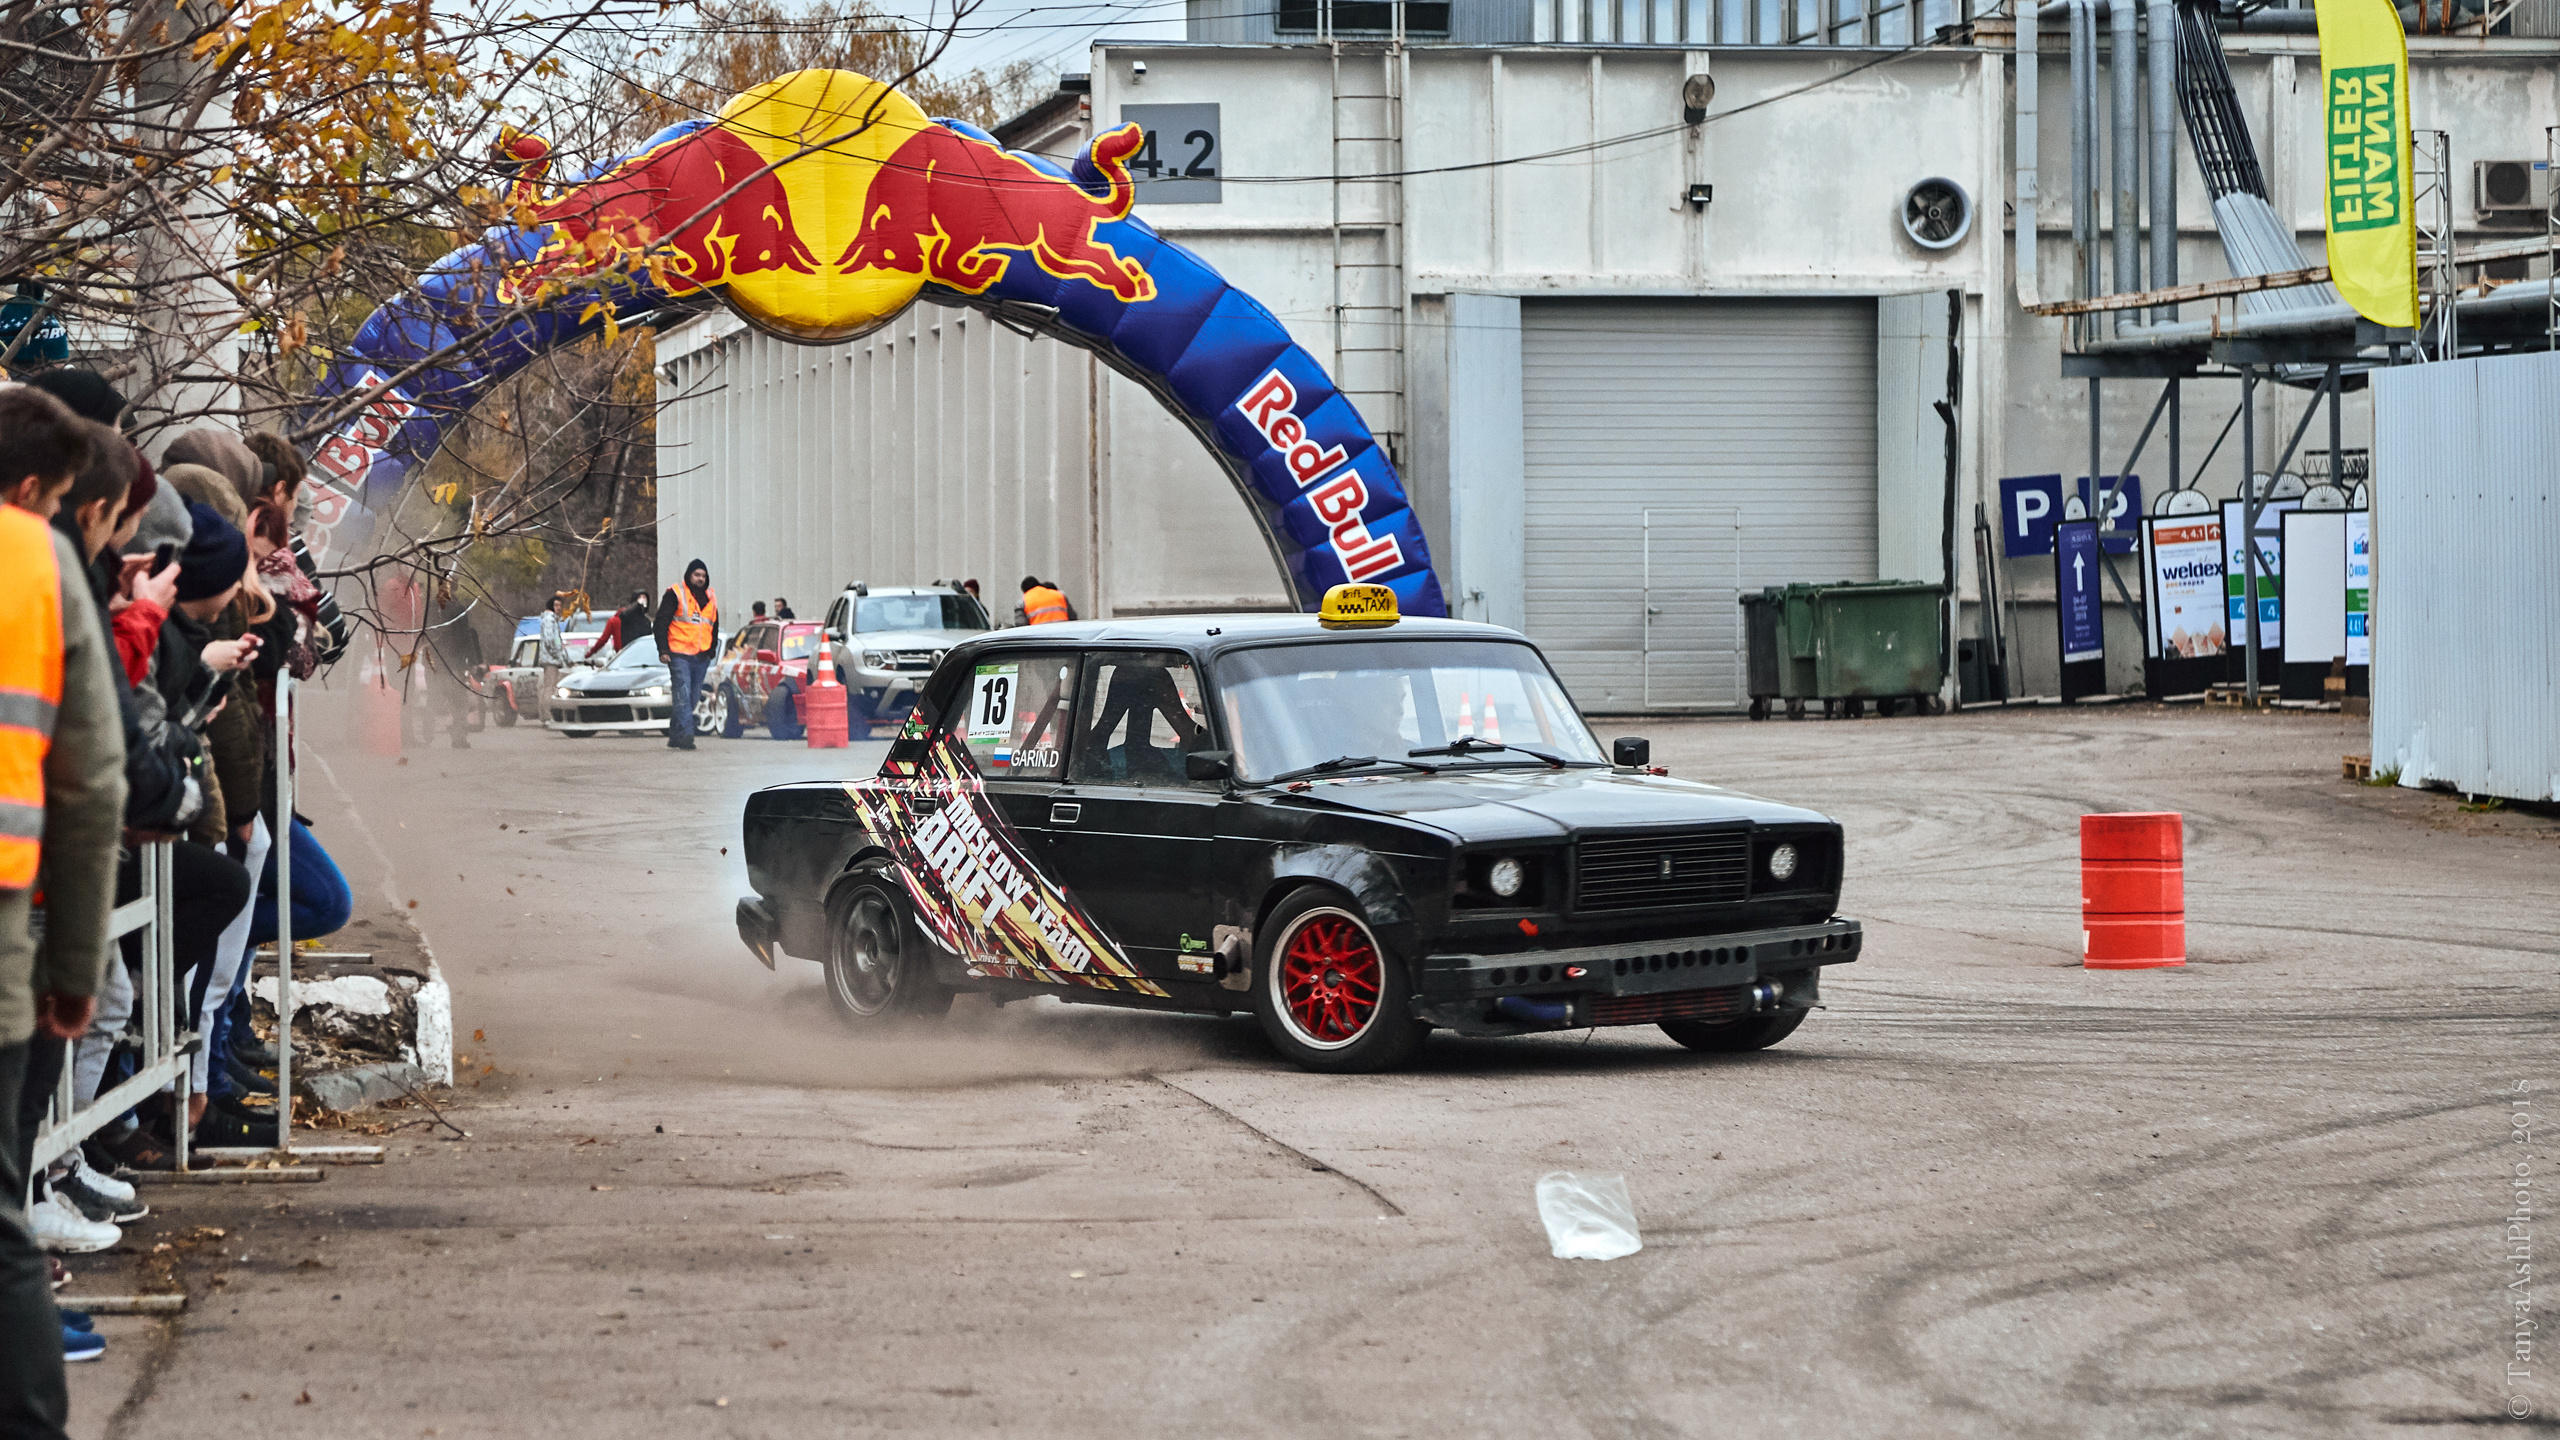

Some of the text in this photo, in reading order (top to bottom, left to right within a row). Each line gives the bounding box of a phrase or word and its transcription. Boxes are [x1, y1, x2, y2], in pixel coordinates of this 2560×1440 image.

[1129, 130, 1215, 178] 4.2
[1237, 369, 1404, 582] Red Bull
[2016, 489, 2050, 536] P
[1343, 589, 1361, 599] Drift
[2163, 561, 2223, 581] weldex
[1362, 597, 1390, 612] TAXI
[982, 677, 1009, 725] 13
[1010, 749, 1059, 768] GARIN.D
[912, 808, 1012, 928] DRIFT
[944, 793, 1033, 901] MOSCOW
[1029, 895, 1092, 972] TEAM
